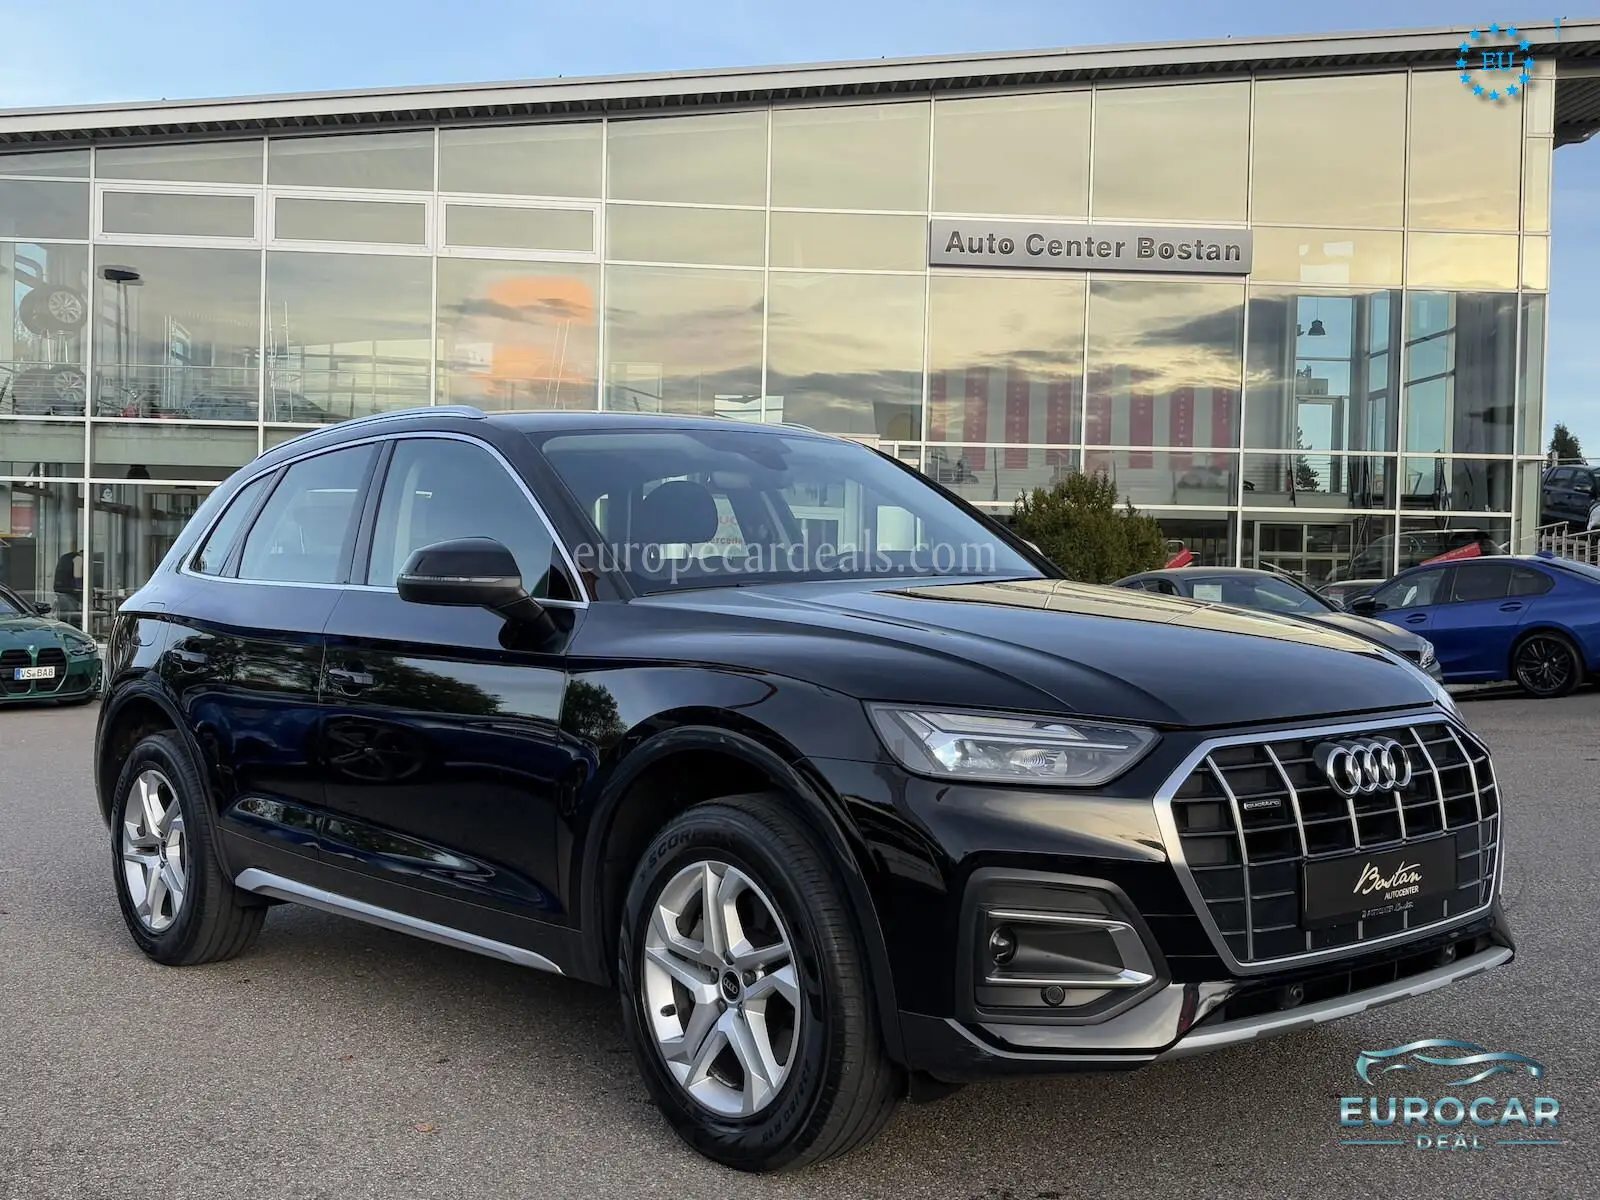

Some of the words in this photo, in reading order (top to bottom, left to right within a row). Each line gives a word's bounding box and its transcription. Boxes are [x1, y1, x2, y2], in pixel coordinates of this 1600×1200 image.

[945, 231, 1015, 255] Auto
[1025, 233, 1126, 258] Center
[1136, 237, 1241, 261] Bostan
[1246, 800, 1280, 809] quattro
[1353, 861, 1423, 895] Bostan
[1384, 885, 1419, 900] AUTOCENTER
